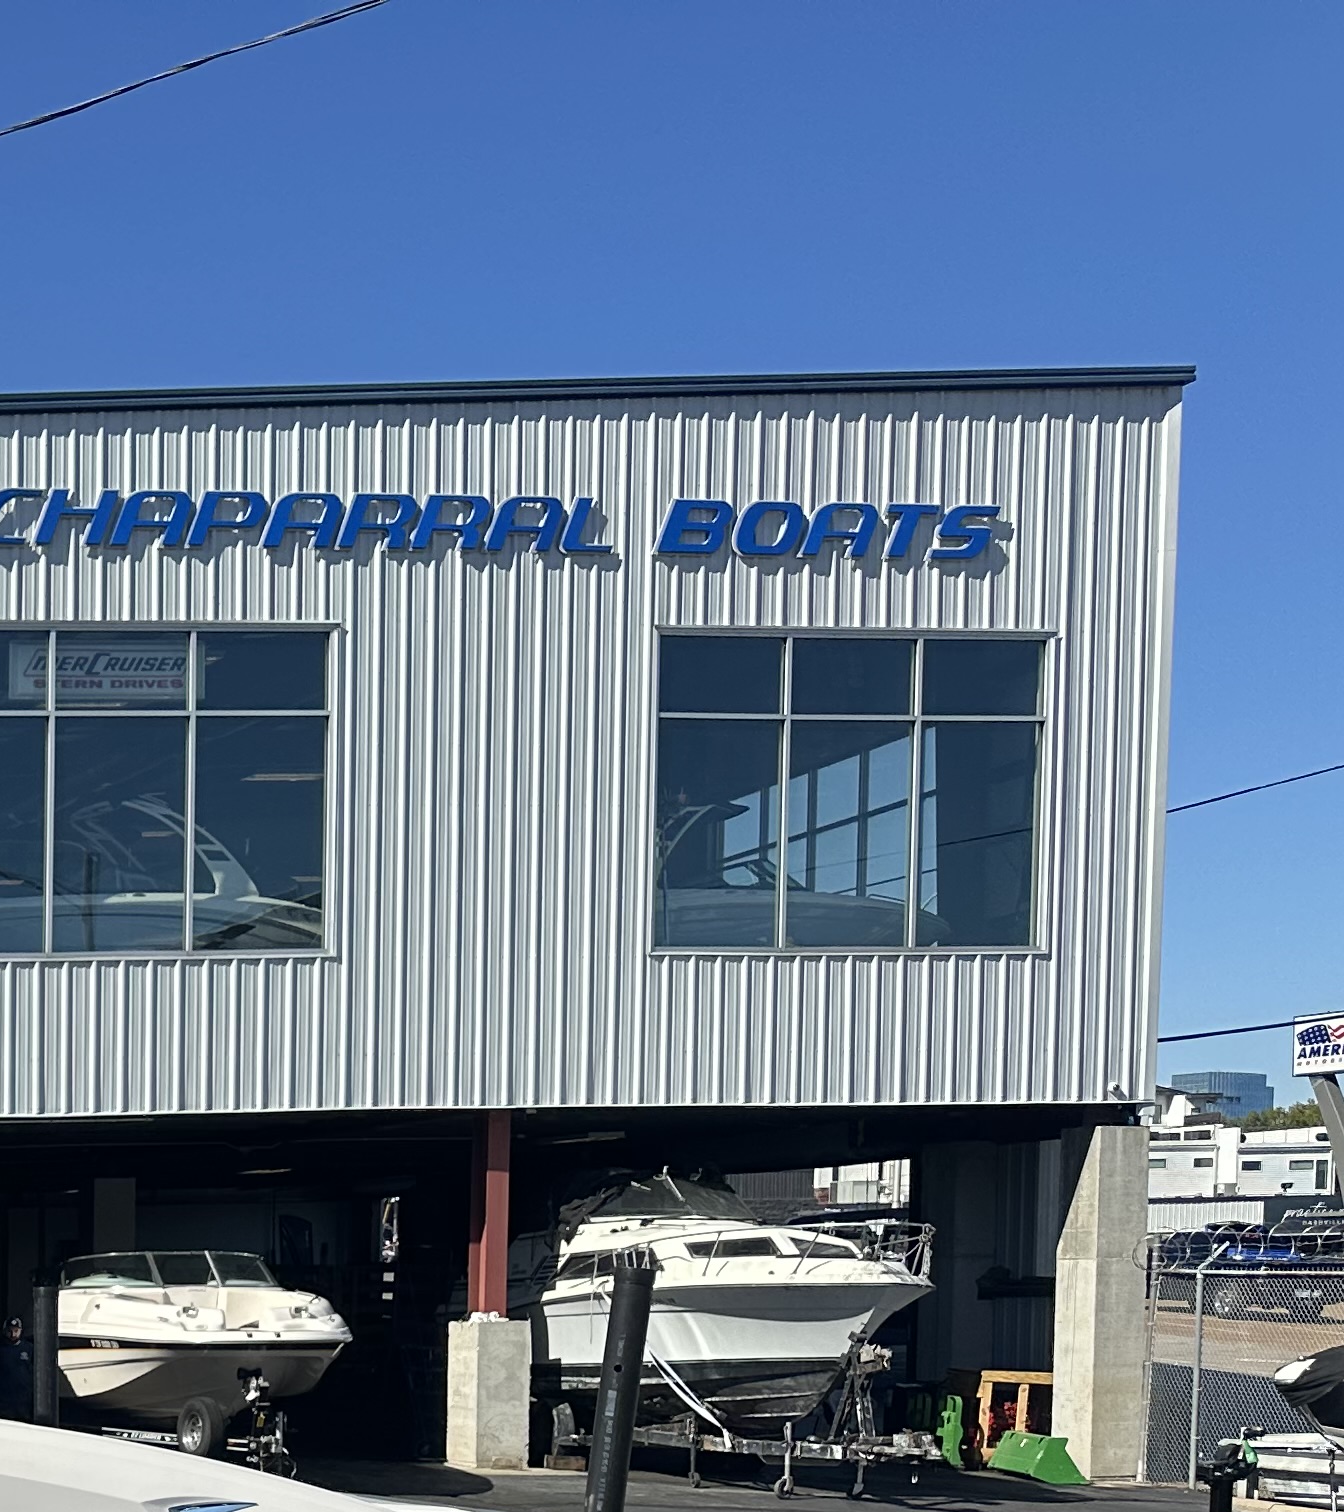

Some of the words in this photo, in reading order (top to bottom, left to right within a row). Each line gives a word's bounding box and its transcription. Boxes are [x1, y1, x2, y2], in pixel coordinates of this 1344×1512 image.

[650, 497, 999, 561] BOATS
[109, 678, 184, 689] DRIVES
[1297, 1043, 1344, 1060] AMER
